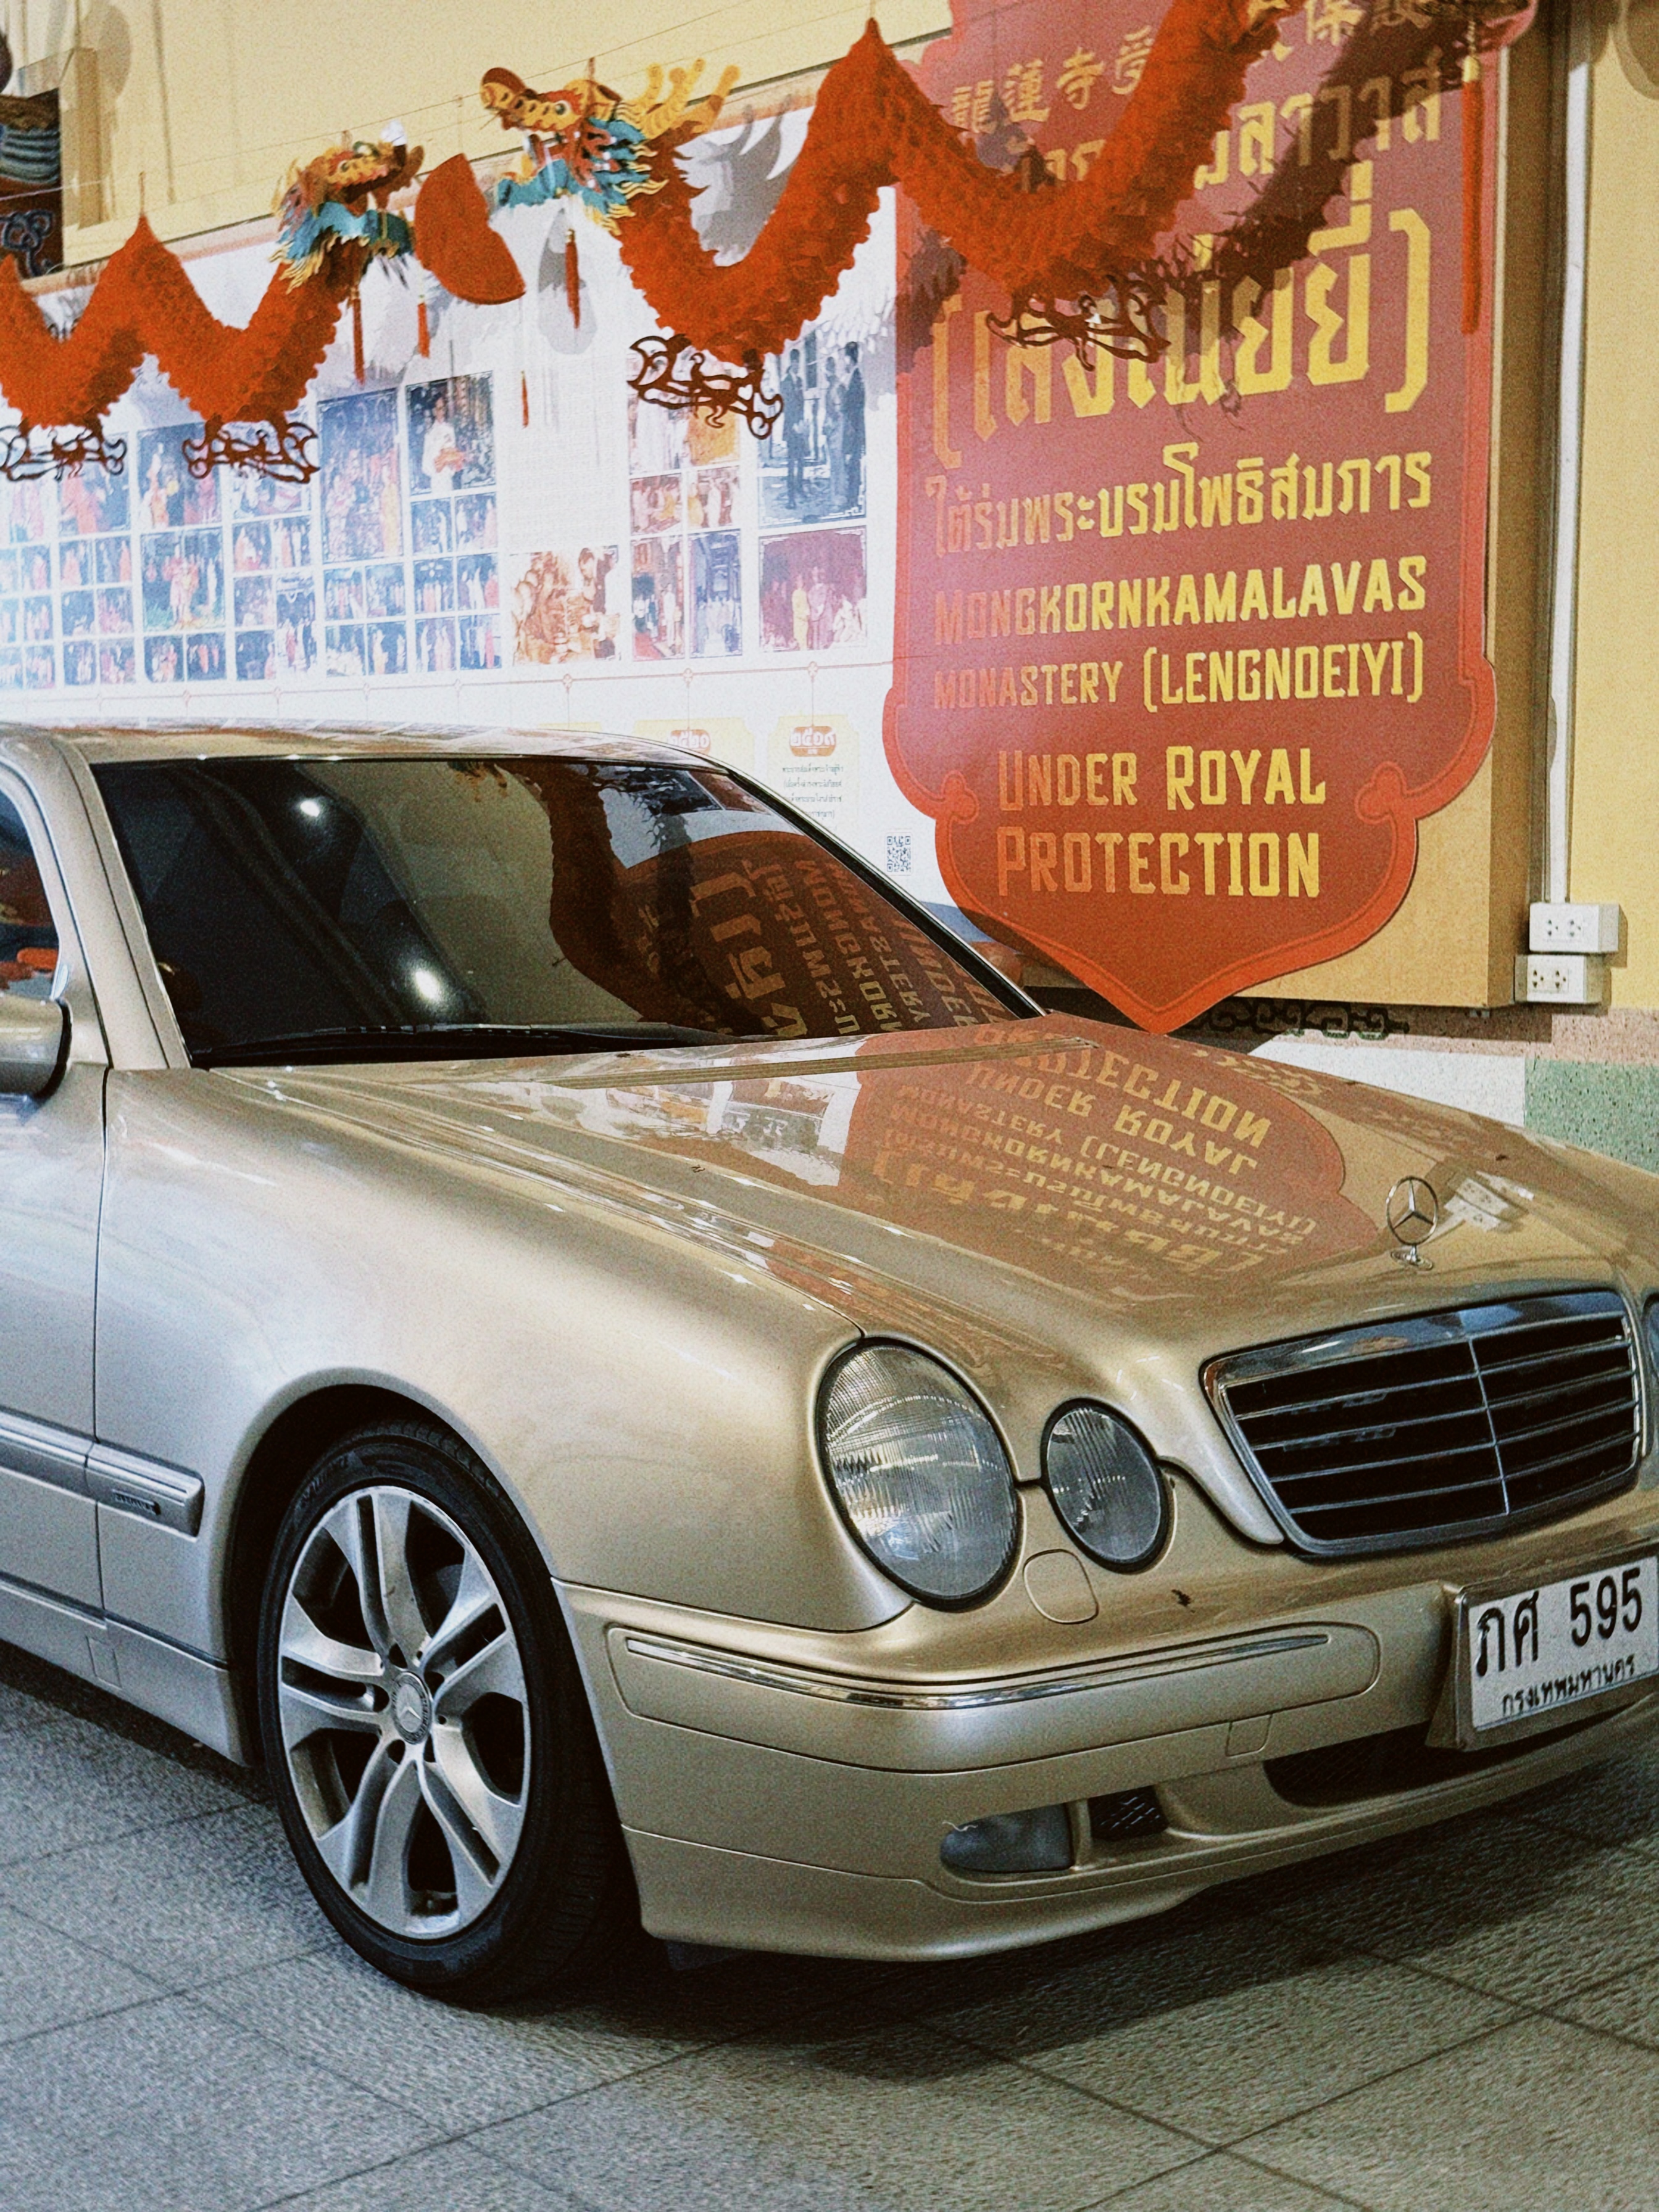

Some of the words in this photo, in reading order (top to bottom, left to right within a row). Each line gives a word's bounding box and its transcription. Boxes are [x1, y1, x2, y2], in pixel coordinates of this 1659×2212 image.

[926, 442, 1432, 558] ใต้ร่มพระบรมโพธิสมภาร
[935, 555, 1427, 646] MONGKORNKAMALAVAS
[934, 661, 1123, 709] MONASTERY
[1144, 631, 1423, 712] (LENGNOEIYI)
[999, 749, 1137, 811] UNDER
[1166, 746, 1326, 810] ROYAL
[997, 826, 1320, 897] PROTECTION
[1570, 1567, 1642, 1647] 595
